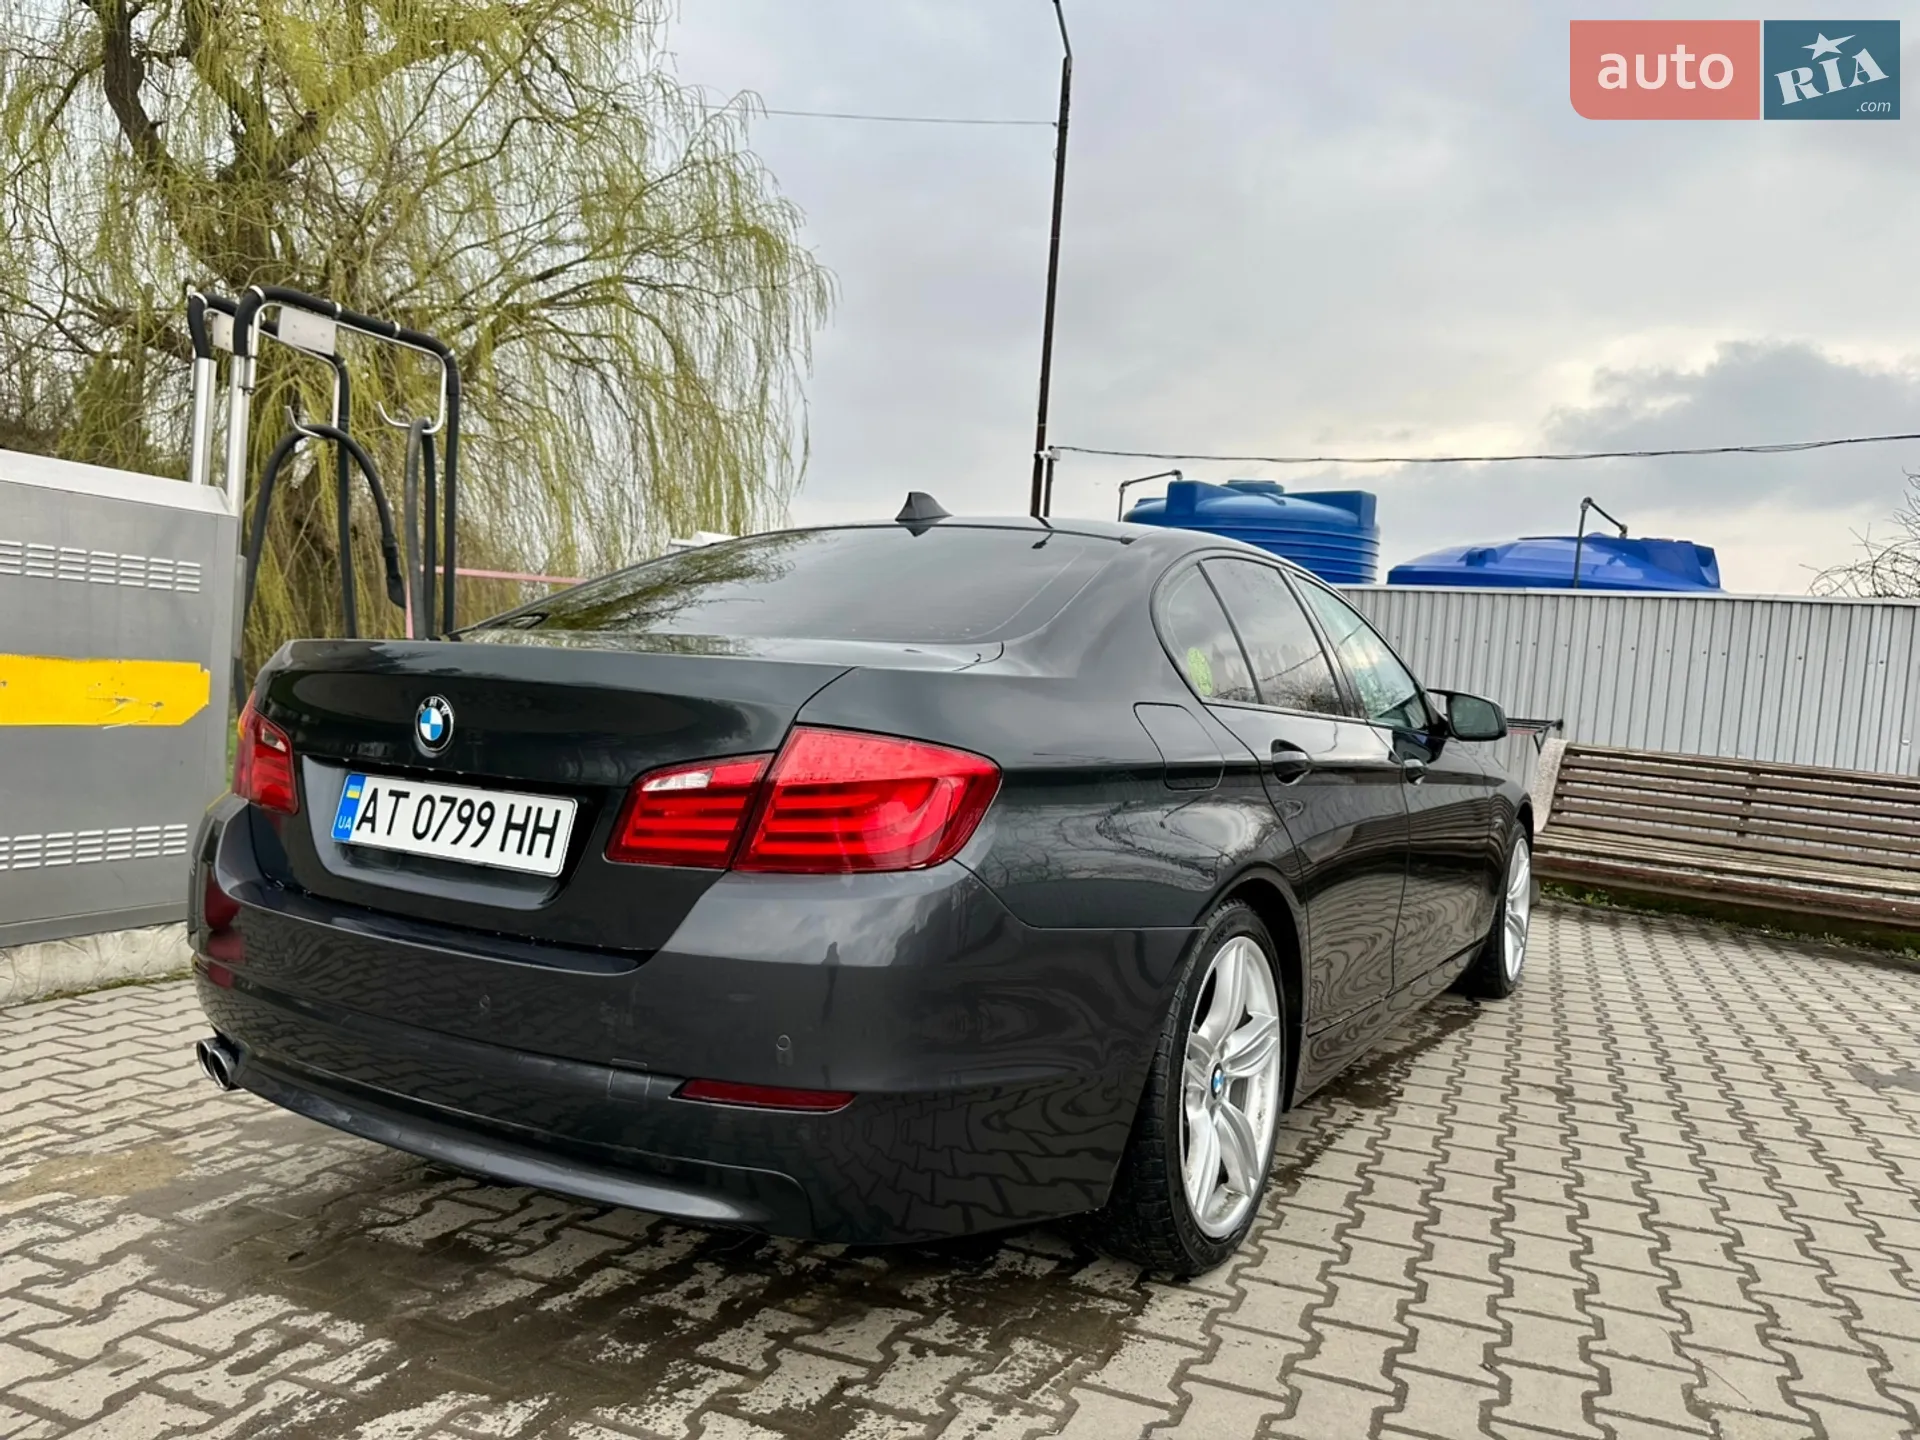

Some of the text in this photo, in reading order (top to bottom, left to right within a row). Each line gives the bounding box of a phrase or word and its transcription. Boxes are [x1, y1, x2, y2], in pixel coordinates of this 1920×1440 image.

[338, 815, 352, 830] UA
[355, 788, 561, 859] AT 0799 HH
